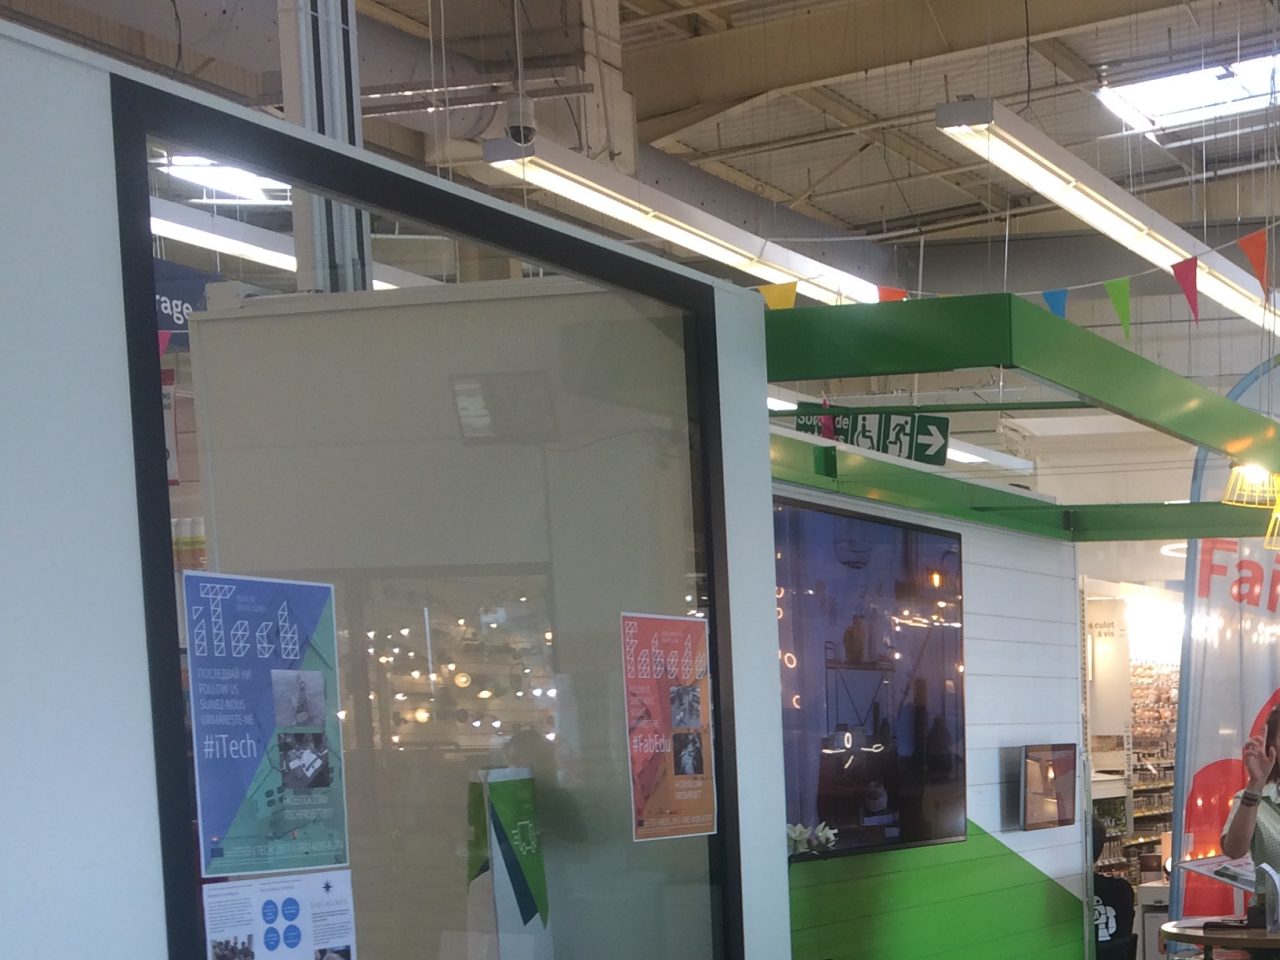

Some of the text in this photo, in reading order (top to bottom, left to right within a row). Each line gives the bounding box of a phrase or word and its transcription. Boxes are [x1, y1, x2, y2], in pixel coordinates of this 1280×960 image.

[192, 583, 300, 660] iTech
[202, 732, 258, 760] #iTech
[632, 732, 671, 753] #FabEdu
